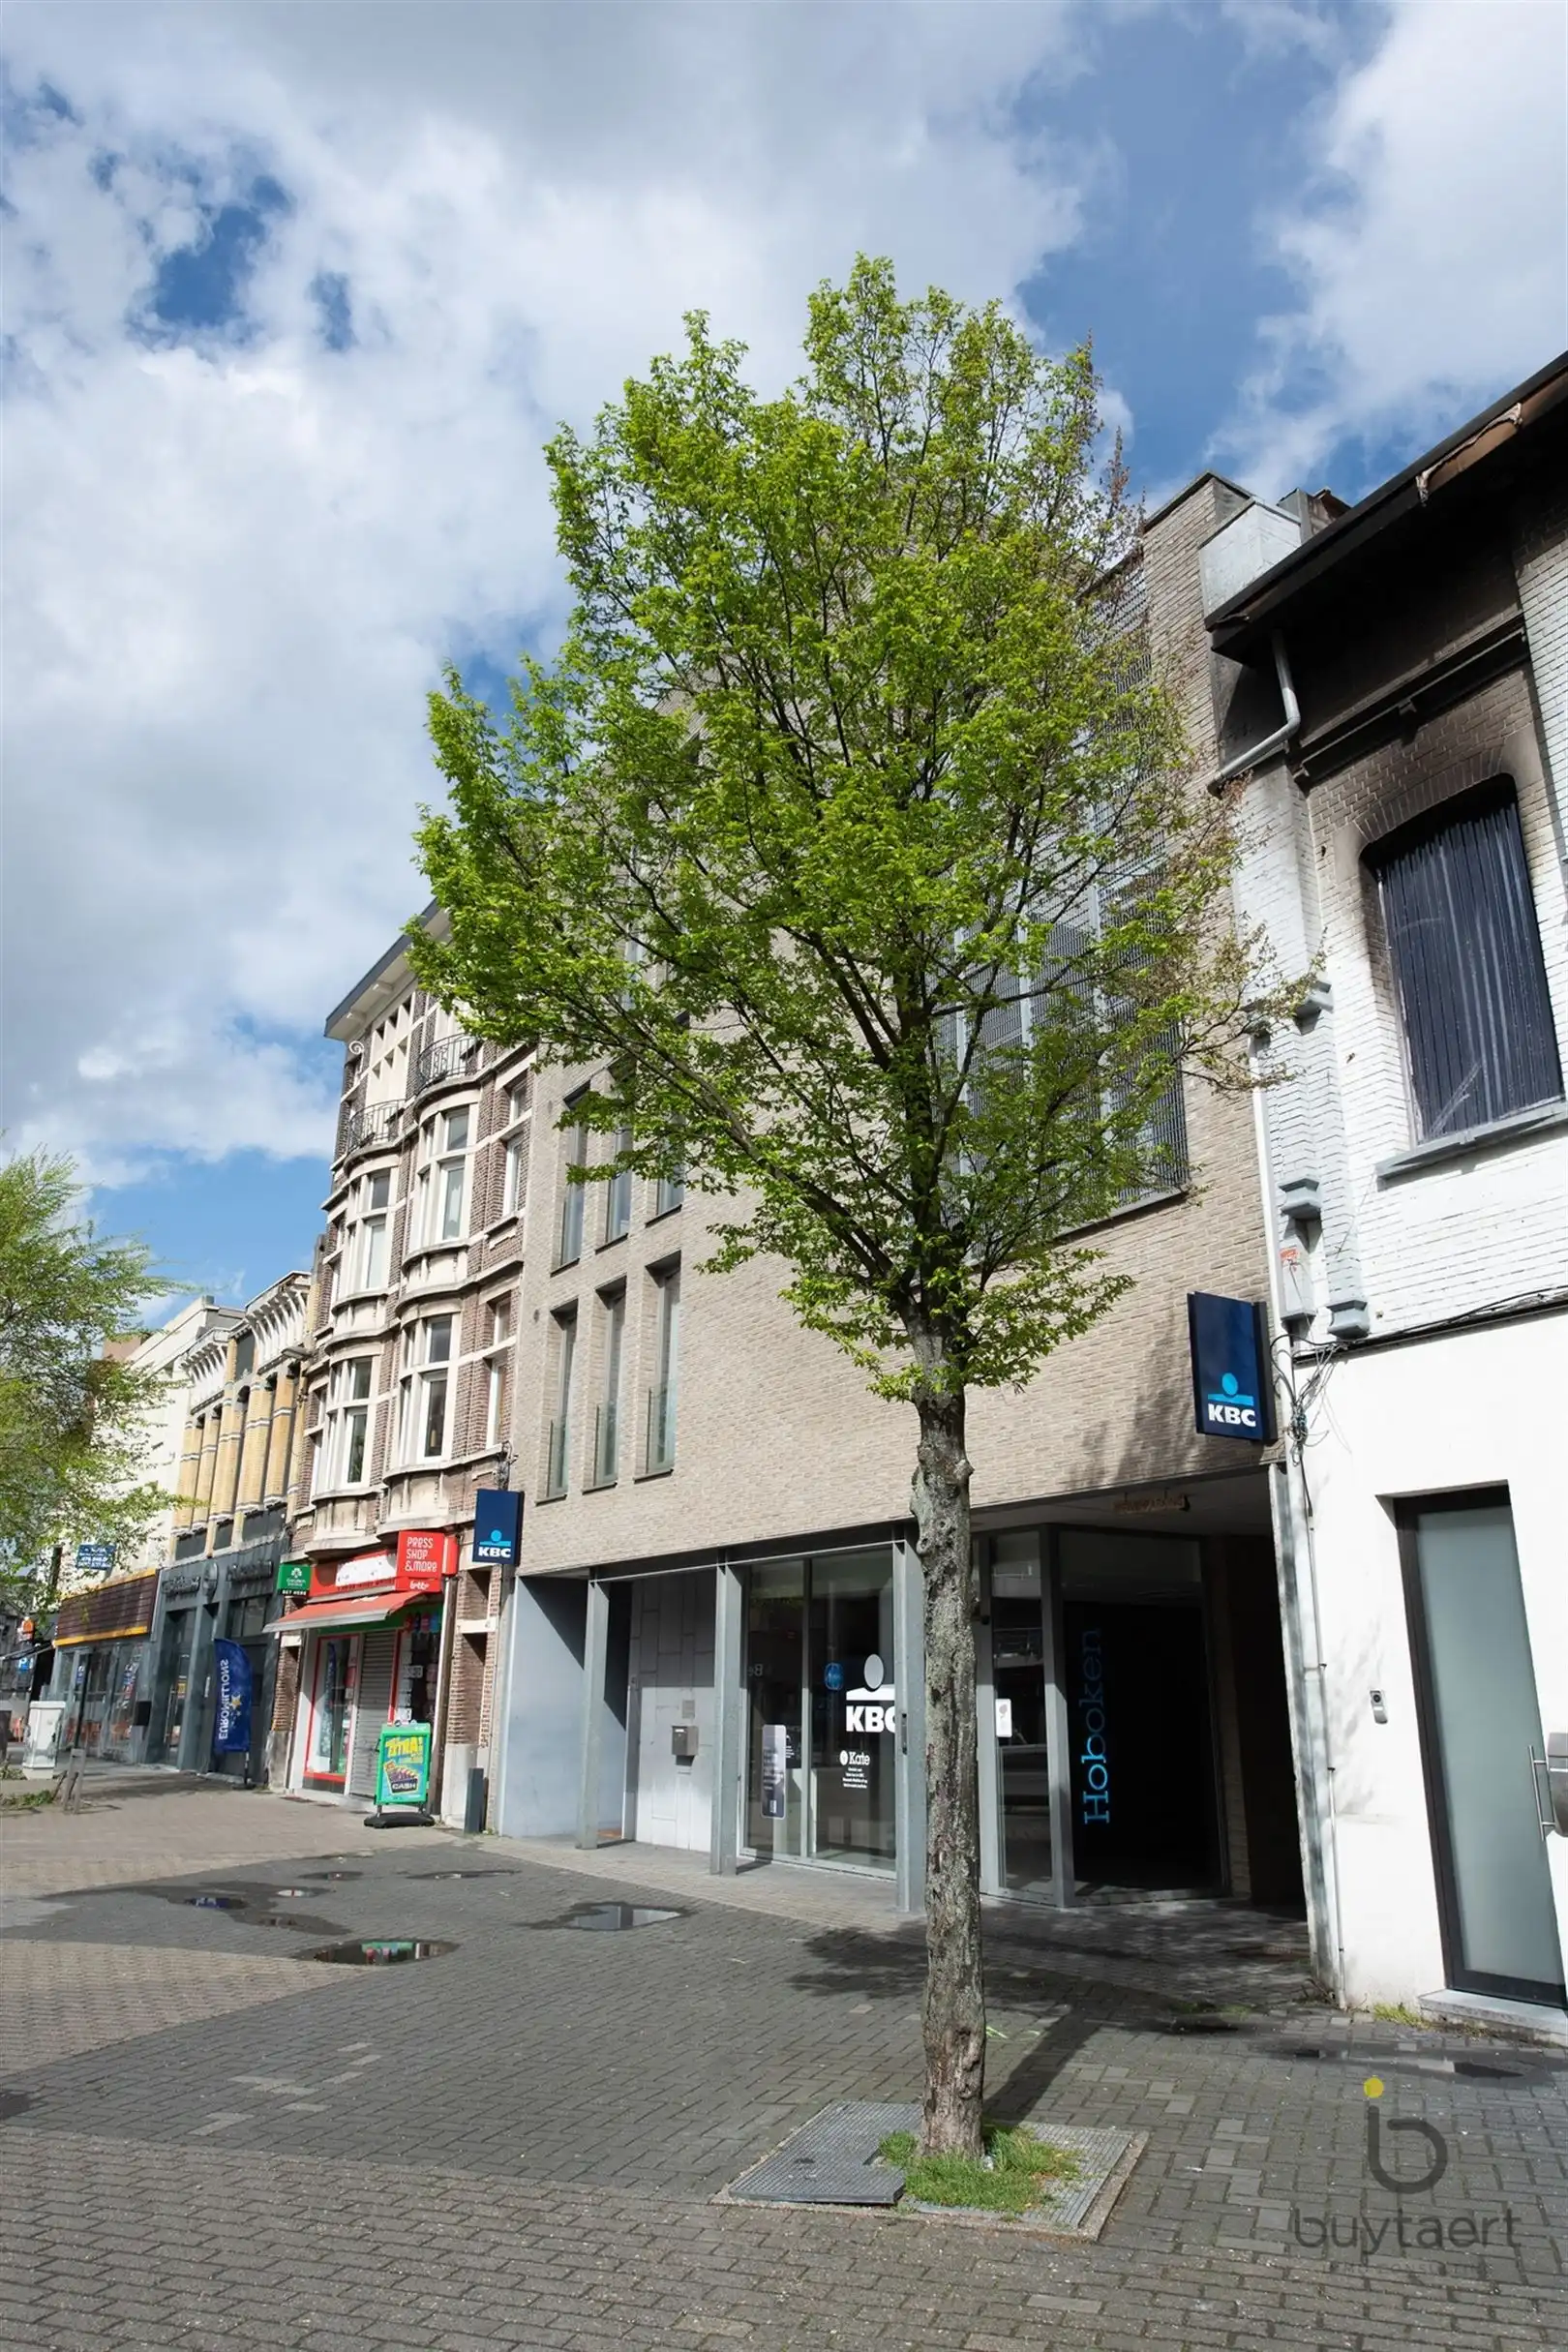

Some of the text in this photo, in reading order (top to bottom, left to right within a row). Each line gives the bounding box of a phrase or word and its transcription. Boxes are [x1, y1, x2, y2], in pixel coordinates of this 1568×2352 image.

[1208, 1402, 1256, 1429] KBC
[407, 1537, 434, 1549] PRESS
[406, 1549, 429, 1559] SHOP
[478, 1547, 512, 1557] KBC
[1078, 1627, 1110, 1824] Hoboken
[849, 1751, 870, 1765] Kate
